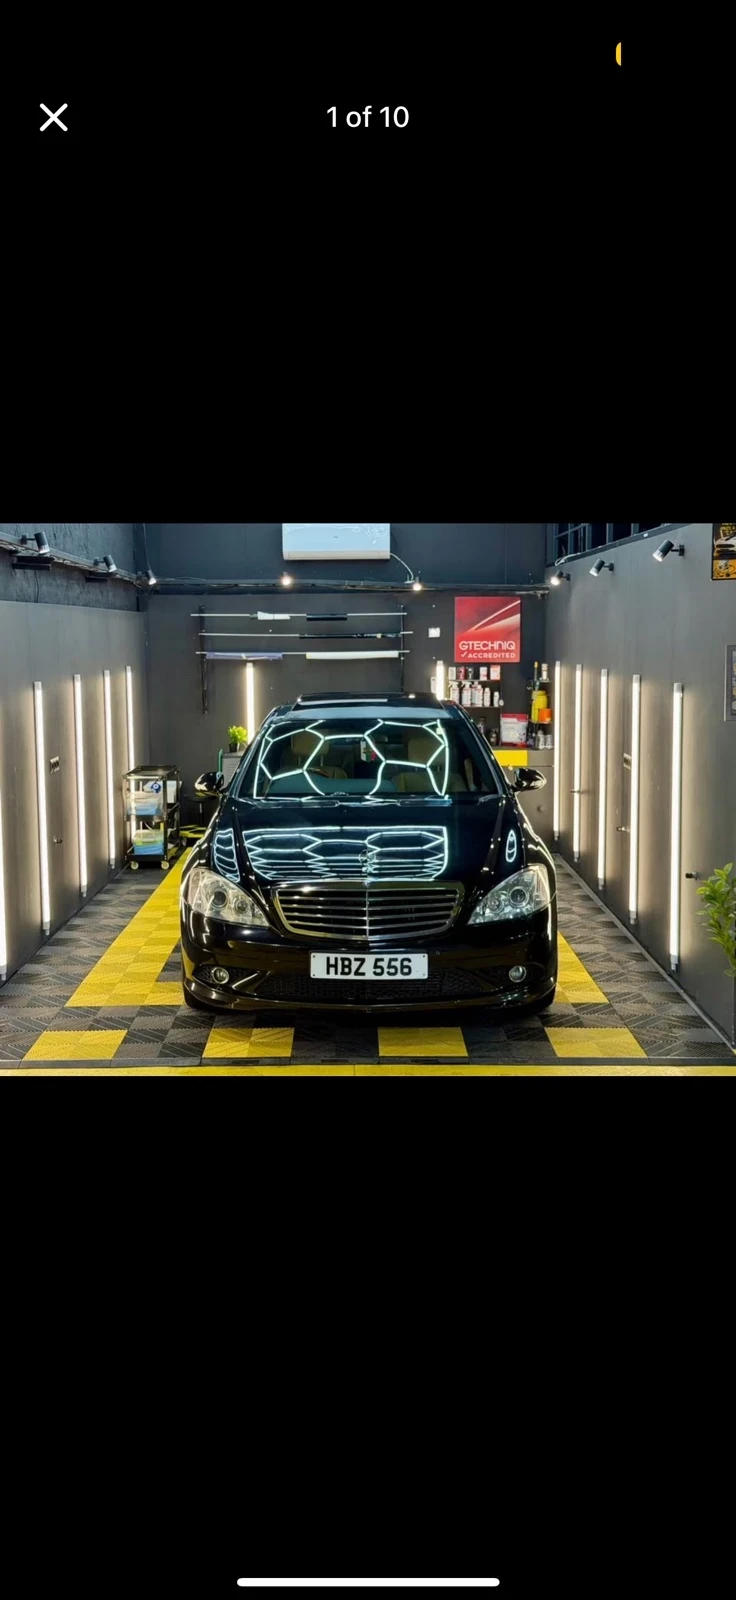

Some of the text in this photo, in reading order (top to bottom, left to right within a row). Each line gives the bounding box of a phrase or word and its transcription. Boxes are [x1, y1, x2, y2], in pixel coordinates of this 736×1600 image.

[458, 640, 516, 651] GTECHNIQ
[326, 956, 412, 977] HBZ 556
